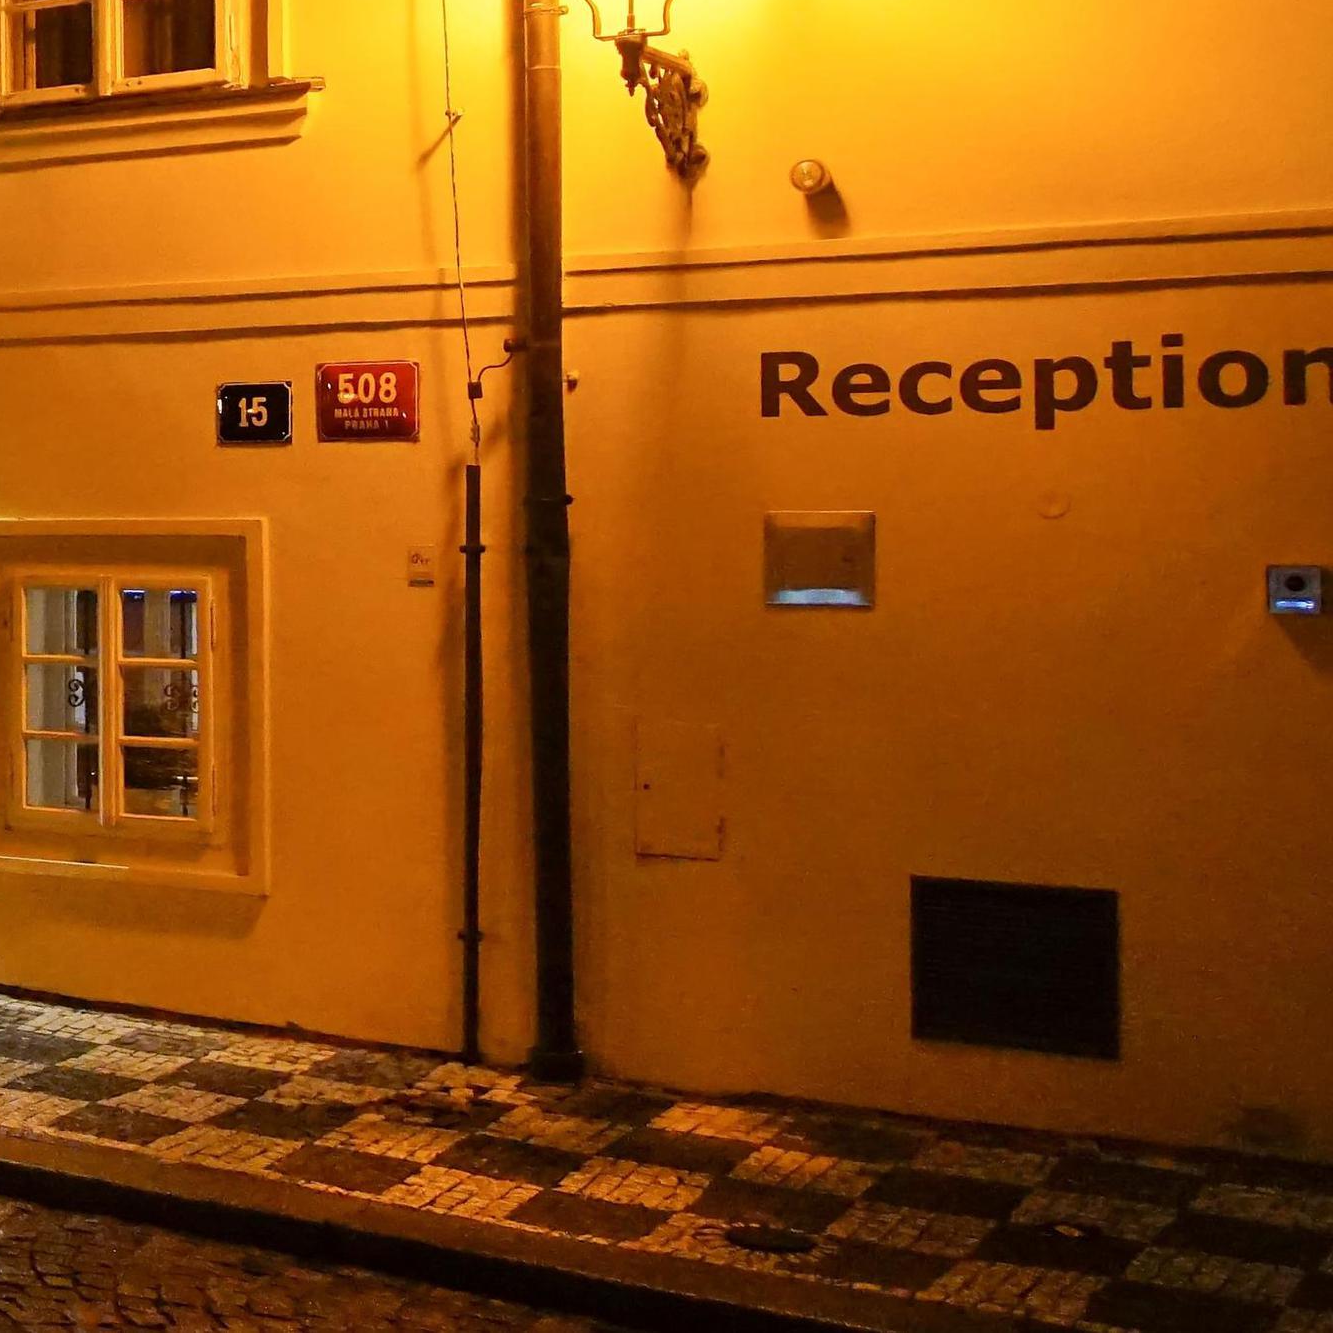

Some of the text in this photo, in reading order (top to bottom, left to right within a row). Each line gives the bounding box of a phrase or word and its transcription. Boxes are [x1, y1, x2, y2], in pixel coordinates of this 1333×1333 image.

[337, 372, 397, 404] 508
[759, 333, 1333, 430] Reception
[238, 396, 268, 427] 15
